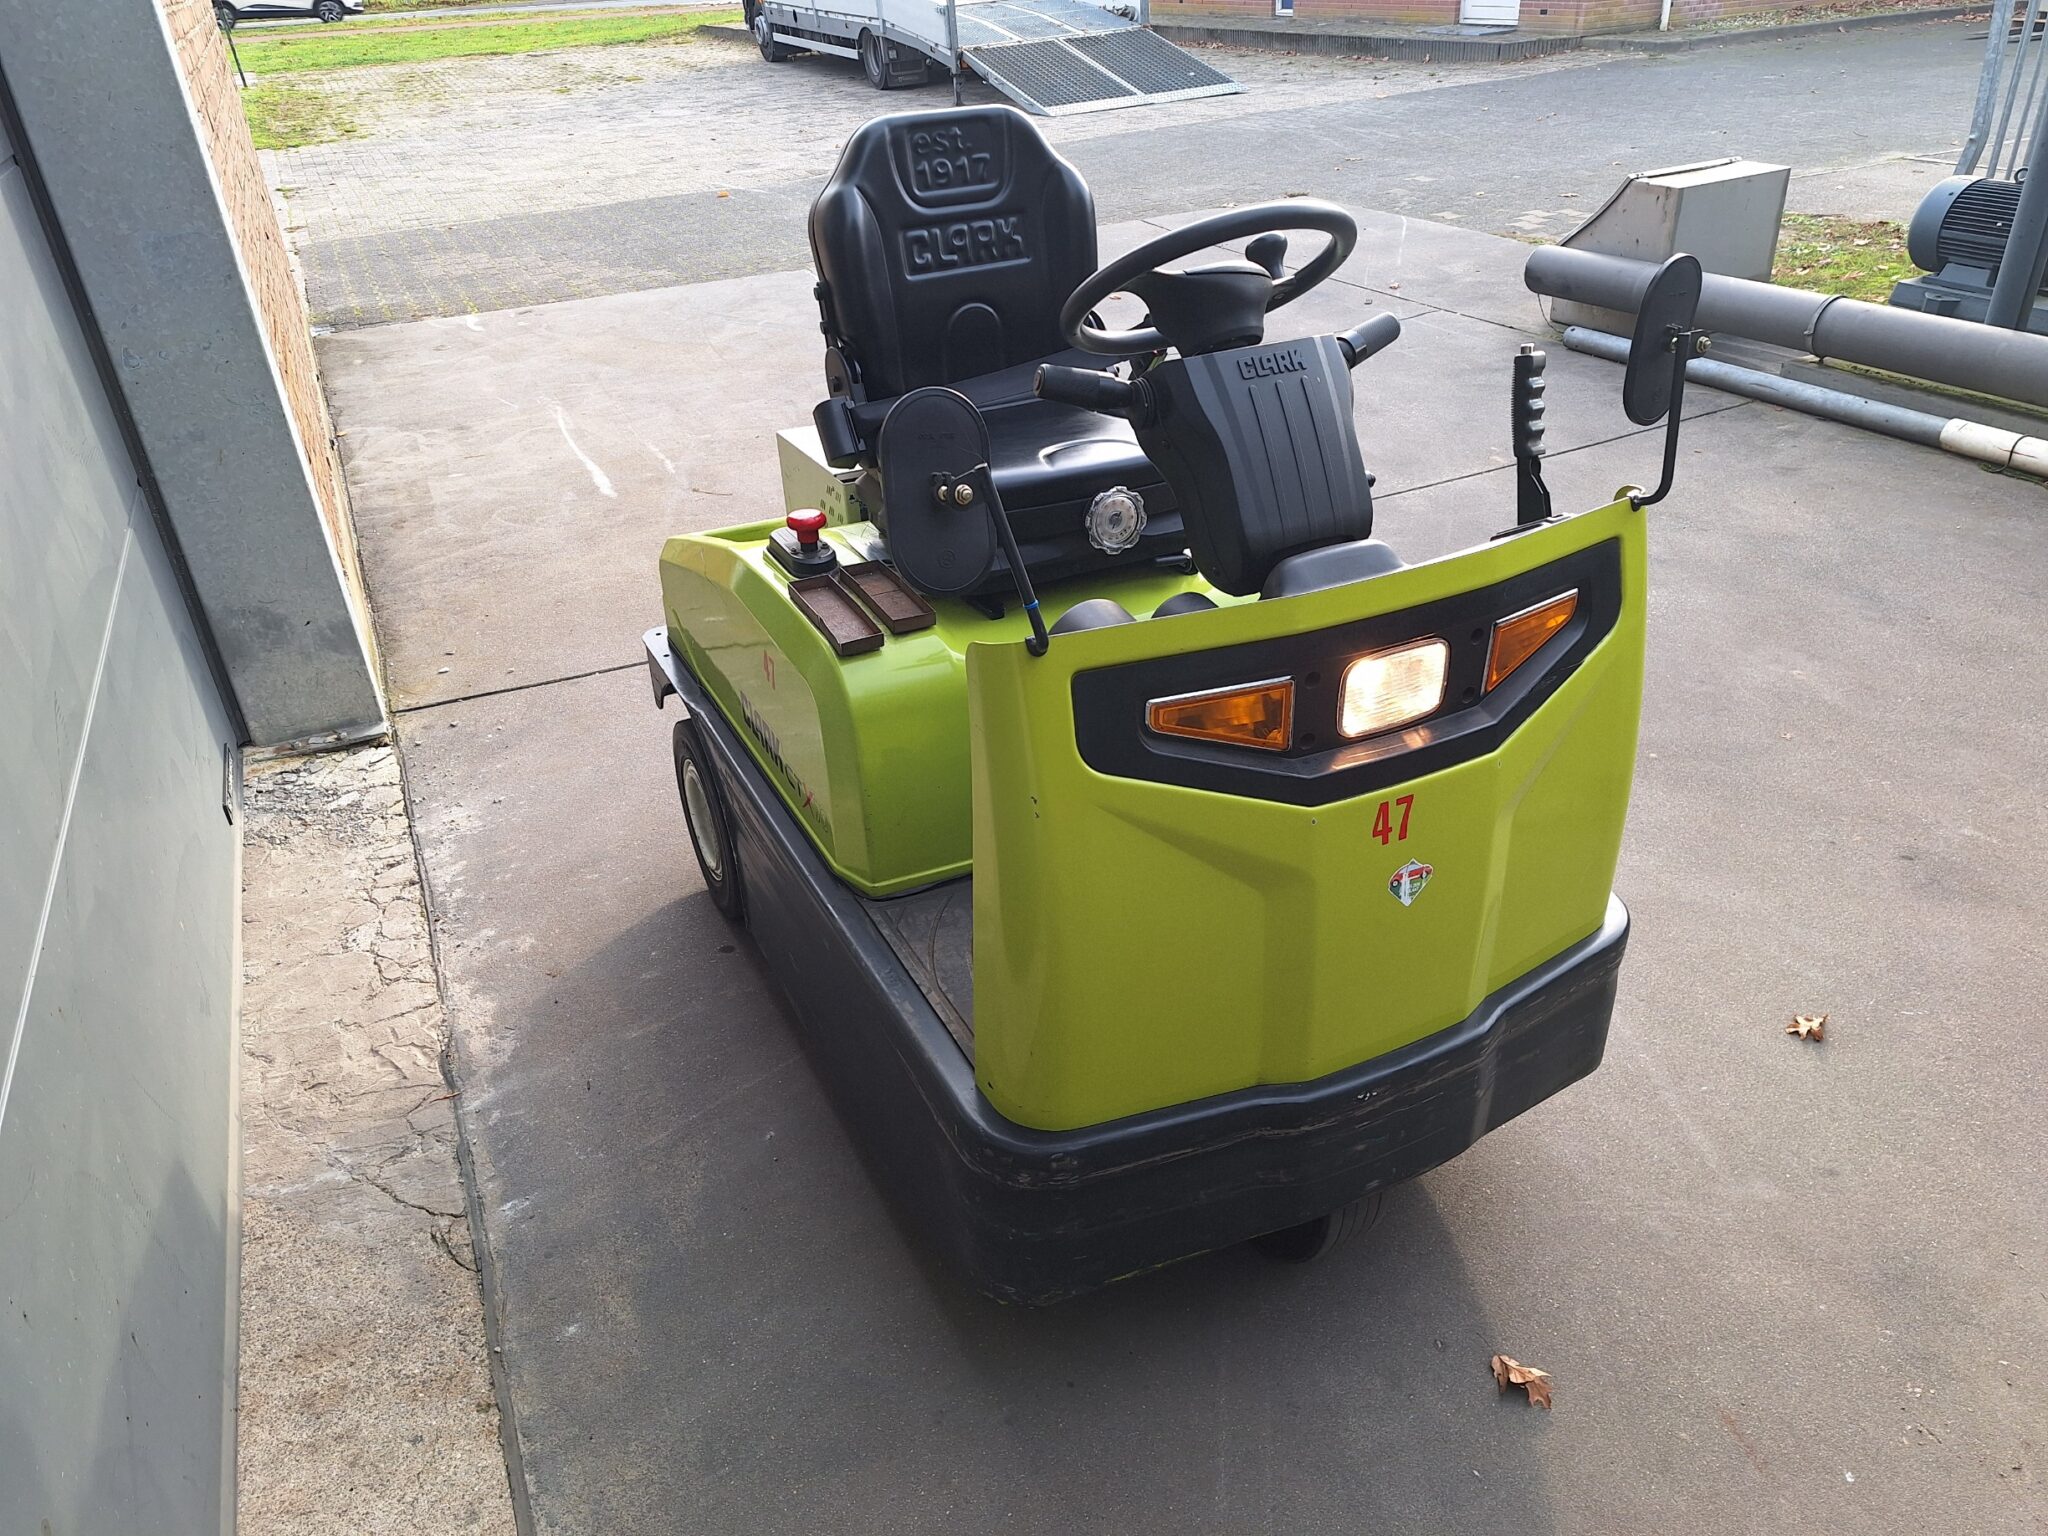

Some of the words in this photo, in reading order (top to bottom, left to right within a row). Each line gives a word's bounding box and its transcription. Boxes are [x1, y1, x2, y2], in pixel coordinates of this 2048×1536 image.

[916, 153, 990, 186] 1917
[905, 217, 1025, 264] CLARK
[1237, 349, 1307, 380] CLARK
[1372, 793, 1414, 845] 47
